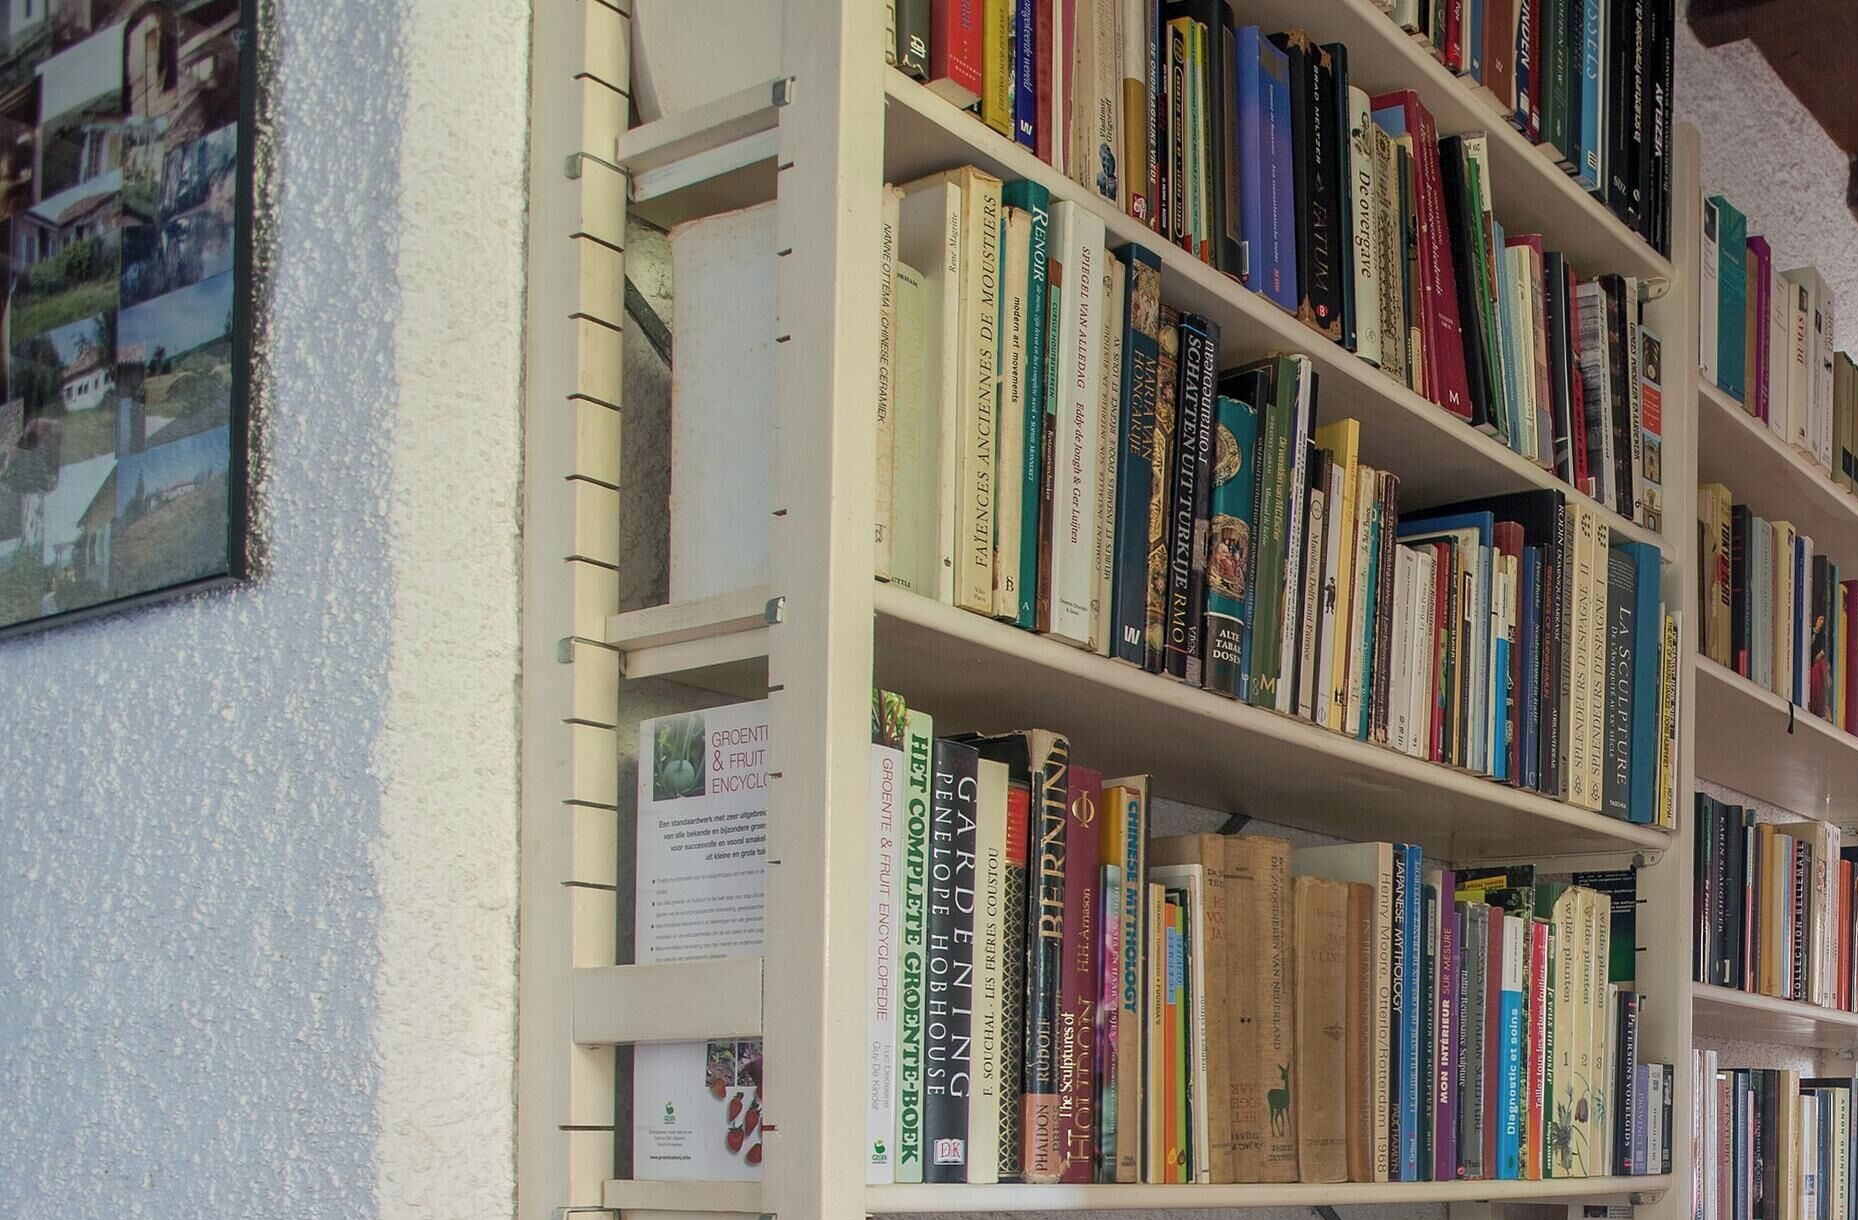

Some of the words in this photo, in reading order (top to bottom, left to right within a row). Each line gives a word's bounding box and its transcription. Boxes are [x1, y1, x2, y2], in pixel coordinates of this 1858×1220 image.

[1024, 58, 1032, 92] wereld
[1359, 171, 1370, 196] De
[883, 223, 891, 259] NANNE
[949, 212, 958, 248] Magritte
[981, 196, 996, 306] MOUSTIERS
[1032, 206, 1048, 281] RENOIR
[1313, 202, 1328, 290] FATUM
[1356, 198, 1372, 278] overgave
[881, 261, 890, 307] OTTEMA
[949, 251, 957, 273] René
[1078, 246, 1090, 299] SPIEGEL
[980, 314, 993, 340] DE
[1013, 297, 1021, 330] modern
[1050, 302, 1058, 330] CURSUS
[1078, 302, 1089, 328] VAN
[879, 317, 889, 365] CHINESE
[1012, 334, 1020, 348] art
[1077, 330, 1088, 388] ALLEDAG
[878, 367, 887, 424] CERAMIEK
[1011, 351, 1019, 403] movements
[1129, 349, 1146, 455] HONGARIJE
[1143, 356, 1156, 421] MARIA
[1182, 334, 1202, 449] SCHATTEN
[977, 349, 993, 465] ANCIENNES
[1072, 402, 1084, 428] Eddy
[1070, 444, 1082, 474] Jongh
[1075, 430, 1083, 442] de
[1142, 423, 1154, 462] VAN
[1072, 476, 1081, 486] &
[1072, 488, 1081, 506] Ger
[1179, 452, 1196, 494] UIT
[975, 470, 989, 568] FAÏENCES
[1070, 507, 1080, 543] Luijten
[1174, 496, 1193, 588] TURKIJE
[1580, 563, 1589, 576] II
[1171, 592, 1186, 643] RMO
[1219, 629, 1240, 641] ALTE
[1576, 583, 1588, 667] D'ESPAGNE
[1594, 596, 1604, 674] D'ESPAGNE
[1620, 605, 1630, 635] LA
[1574, 672, 1586, 767] SPLENDEURS
[1592, 680, 1602, 776] SPLENDEURS
[1617, 645, 1630, 784] SCULPTURE
[712, 750, 723, 771] &
[730, 750, 766, 769] FRUIT
[910, 734, 928, 793] HET
[880, 758, 893, 832] GROENTE
[881, 837, 892, 849] &
[932, 772, 953, 915] PENELOPE
[1039, 744, 1067, 939] BERNINI
[1127, 802, 1138, 880] CHINESE
[1272, 856, 1280, 871] DE
[880, 854, 891, 896] FRUIT
[905, 798, 925, 945] COMPLETE
[987, 848, 998, 916] COUSTOU
[1380, 873, 1391, 919] Henry
[1395, 860, 1405, 923] JAPANESE
[1795, 844, 1804, 915] BELLEMARE
[950, 776, 978, 1098] GARDENING
[1078, 888, 1090, 940] Arnason
[1272, 875, 1280, 949] ZOOGDIEREN
[1563, 902, 1572, 943] wilde
[1584, 905, 1593, 944] wilde
[877, 903, 890, 1020] ENCYCLOPEDIE
[985, 923, 996, 970] FRÈRES
[1124, 888, 1137, 1013] MYTHOLOGY
[1272, 953, 1280, 977] VAN
[1379, 925, 1390, 979] Moore,
[1393, 928, 1403, 1013] MYTHOLOGY
[1443, 928, 1451, 971] MESURE
[1794, 925, 1802, 998] COLLECTION
[985, 978, 995, 1000] LES
[1442, 974, 1450, 994] SUR
[1563, 948, 1572, 1002] planten
[1584, 950, 1592, 1004] planten
[1598, 953, 1606, 1008] planten
[928, 935, 948, 1094] HOBHOUSE
[1061, 1014, 1074, 1025] of
[1272, 982, 1281, 1050] NEDERLAND
[1439, 999, 1449, 1066] INTÉRIEUR
[1510, 1008, 1518, 1044] soins
[902, 952, 922, 1164] GROENTE-BOEK
[984, 1012, 994, 1079] SOUCHAL
[1037, 1019, 1050, 1080] RUDOLF
[1060, 1026, 1074, 1092] Sculptures
[1378, 987, 1390, 1127] Otterlo/Rotterdam
[1509, 1048, 1517, 1061] et
[1563, 1052, 1569, 1066] 1
[1581, 1054, 1588, 1066] 2
[1597, 1057, 1602, 1068] 3
[1626, 1014, 1636, 1079] PETERSONS
[983, 1088, 993, 1096] F.
[1060, 1096, 1074, 1118] The
[1067, 995, 1092, 1166] HOUDON
[1440, 1071, 1449, 1104] MON
[1508, 1065, 1518, 1135] Diagnostic
[1036, 1104, 1048, 1172] PHAIDON
[1625, 1083, 1633, 1146] VOGELGIDS
[940, 1142, 962, 1158] DK
[1377, 1136, 1388, 1173] 1968
